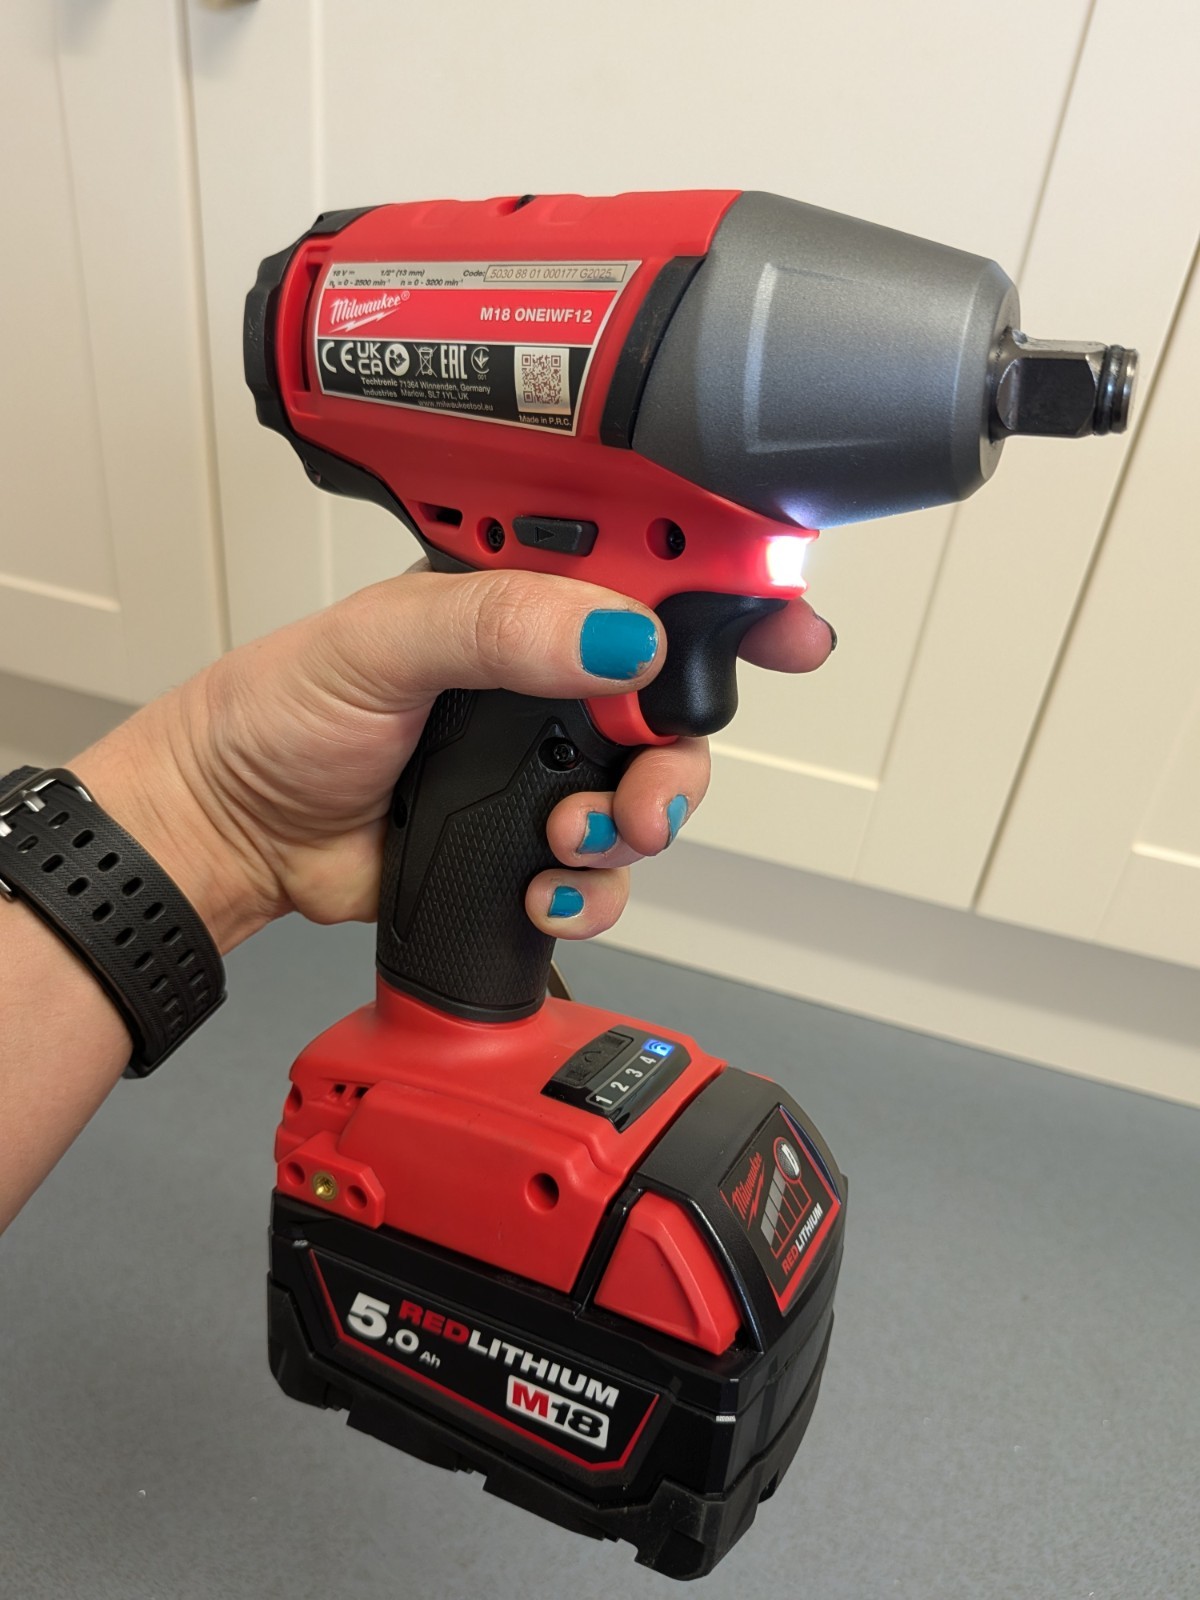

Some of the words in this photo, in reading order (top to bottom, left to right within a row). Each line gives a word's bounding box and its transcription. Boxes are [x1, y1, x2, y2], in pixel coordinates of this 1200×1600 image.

[463, 269, 485, 277] Code:
[490, 268, 514, 279] 5030
[515, 268, 528, 279] 88
[529, 268, 541, 279] 01
[543, 268, 579, 279] 000177
[580, 268, 612, 279] G2025
[480, 307, 511, 321] M18
[514, 308, 593, 324] ONEIWF12
[322, 341, 356, 374] CE
[357, 342, 382, 359] UK
[358, 359, 384, 376] CA
[440, 344, 468, 380] EAC
[361, 377, 398, 388] Techtronic
[400, 380, 419, 389] 71364
[420, 382, 458, 392] Winnenden,
[460, 383, 491, 395] Germany
[363, 388, 398, 398] Industries
[427, 390, 440, 399] SL7
[458, 392, 470, 401] UK
[518, 415, 539, 425] Made
[541, 416, 548, 425] in
[549, 417, 572, 426] P.R.C.
[596, 1095, 613, 1105] 1
[610, 1081, 629, 1092] 2
[625, 1068, 643, 1078] 3
[640, 1055, 657, 1065] 4
[731, 1151, 763, 1221] Milwaukee
[781, 1202, 824, 1275] REDLITHIUM
[346, 1292, 420, 1353] 5.0
[419, 1350, 441, 1369] Ah
[398, 1299, 620, 1410] REDLITHIUM
[511, 1379, 604, 1439] M18
